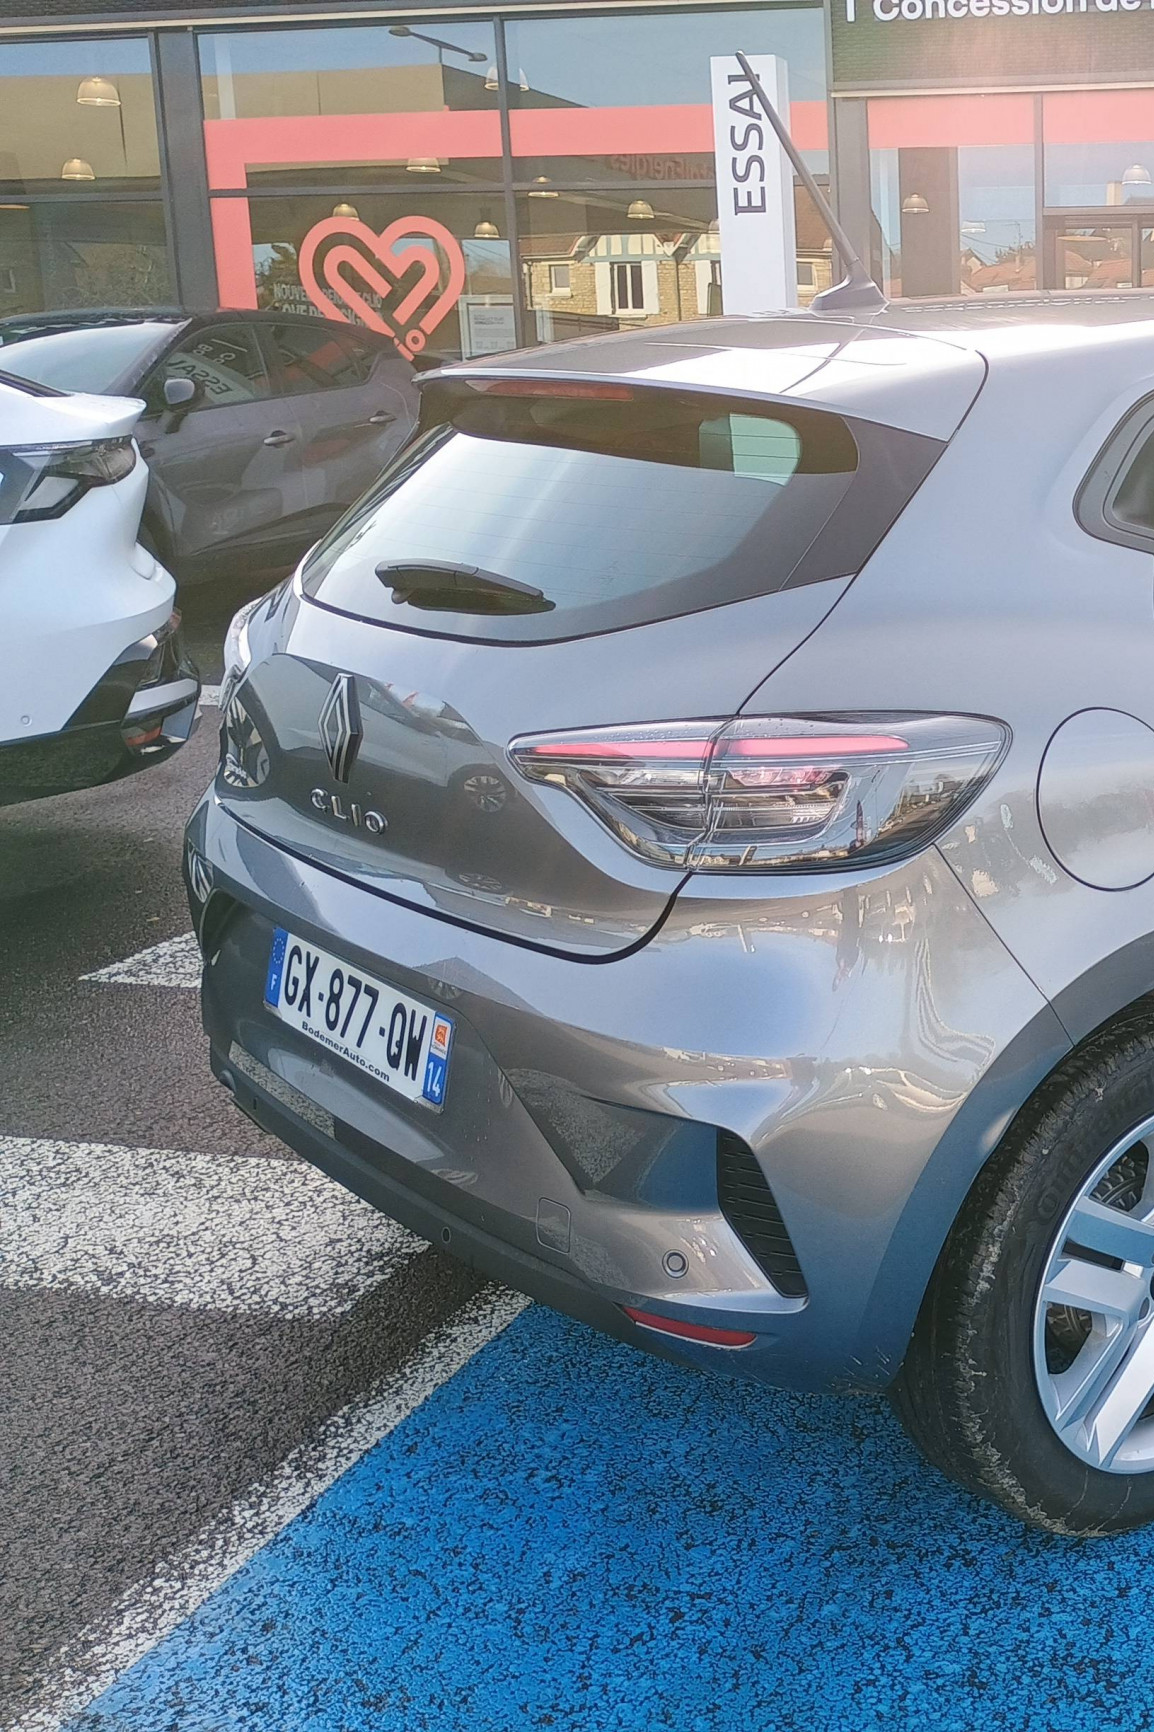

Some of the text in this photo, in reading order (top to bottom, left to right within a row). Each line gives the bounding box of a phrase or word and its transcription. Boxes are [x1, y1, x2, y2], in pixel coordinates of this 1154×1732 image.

[727, 73, 767, 216] ESSAI
[311, 788, 388, 835] CLIO
[270, 974, 278, 991] F
[284, 945, 428, 1082] GX-877-QW
[301, 1020, 391, 1083] BodemerAuto.com
[427, 1061, 442, 1098] 14
